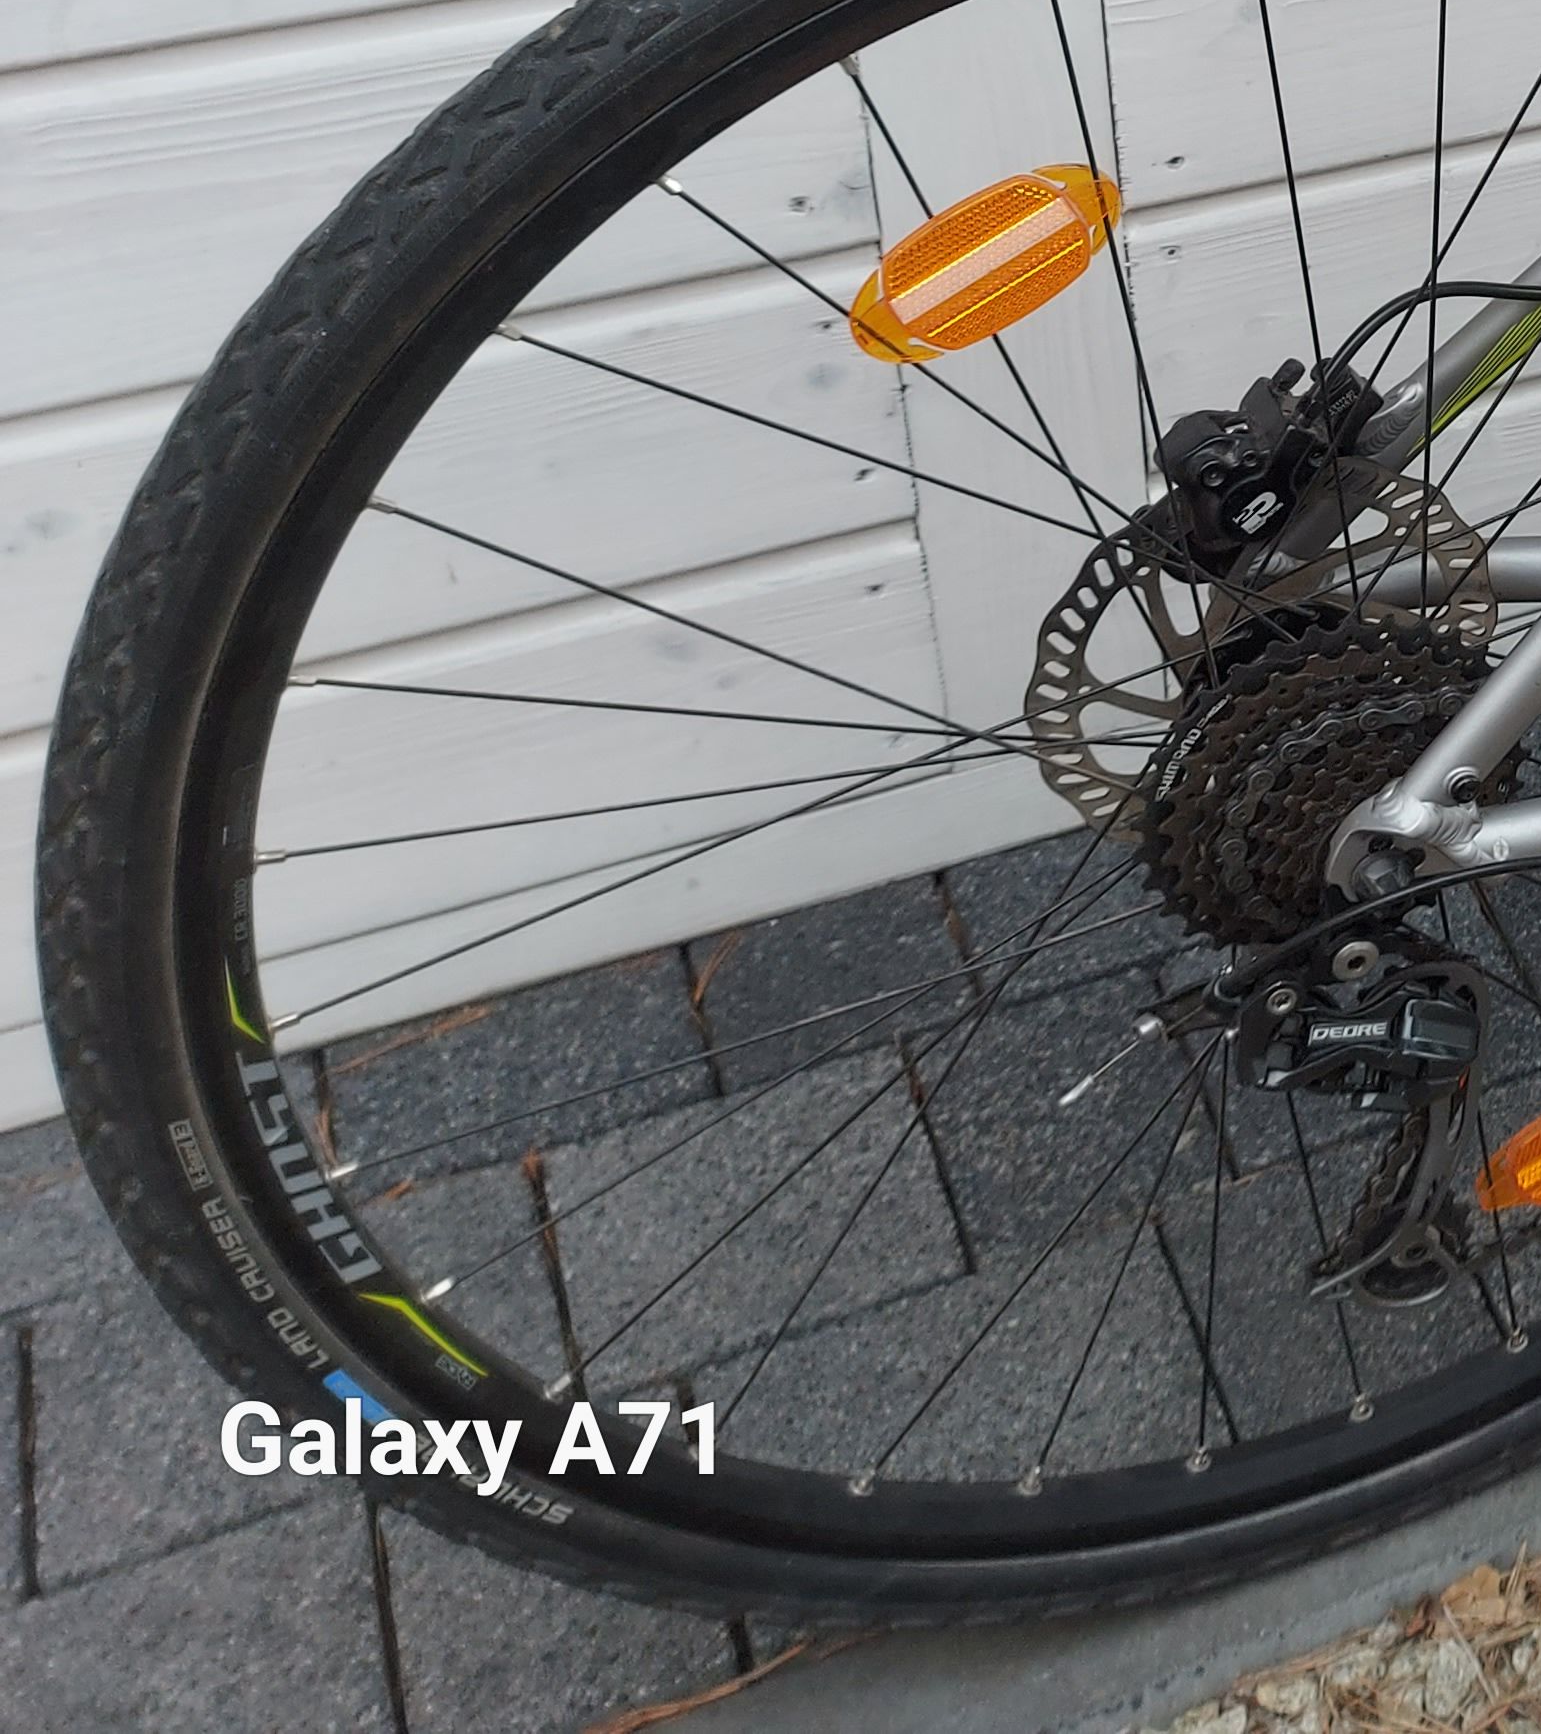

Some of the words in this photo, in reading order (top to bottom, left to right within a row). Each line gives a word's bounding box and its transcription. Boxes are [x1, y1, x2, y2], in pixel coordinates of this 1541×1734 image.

[1311, 1020, 1388, 1042] DEORE
[235, 1051, 384, 1284] GHOST
[201, 1195, 276, 1304] CRUISER
[266, 1306, 330, 1370] LAND
